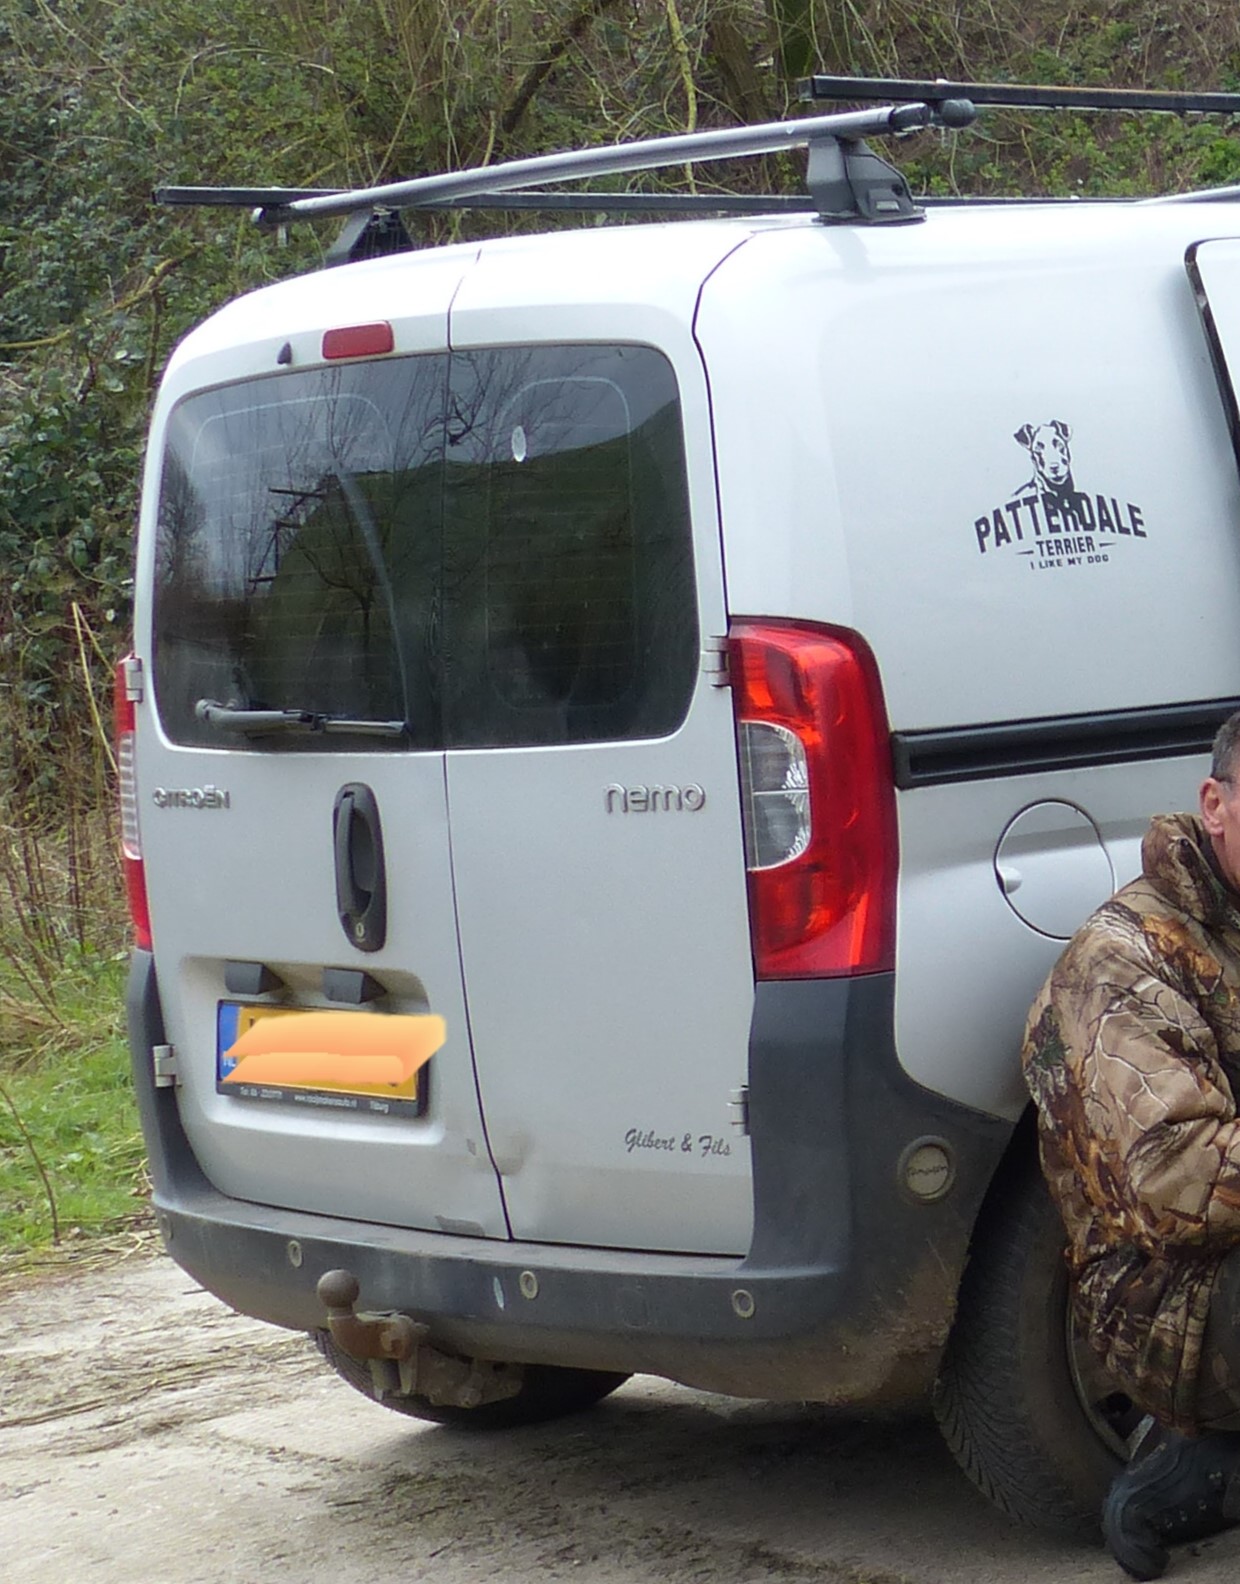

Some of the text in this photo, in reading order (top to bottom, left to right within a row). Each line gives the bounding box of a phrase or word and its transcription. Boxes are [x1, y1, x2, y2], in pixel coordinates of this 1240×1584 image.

[974, 492, 1147, 553] PATTERDALE
[1035, 536, 1096, 557] TERRIER
[1039, 558, 1063, 569] LIKE
[1067, 556, 1083, 566] MY
[1087, 554, 1109, 564] DOG
[681, 1132, 692, 1153] &
[698, 1135, 732, 1158] Fils
